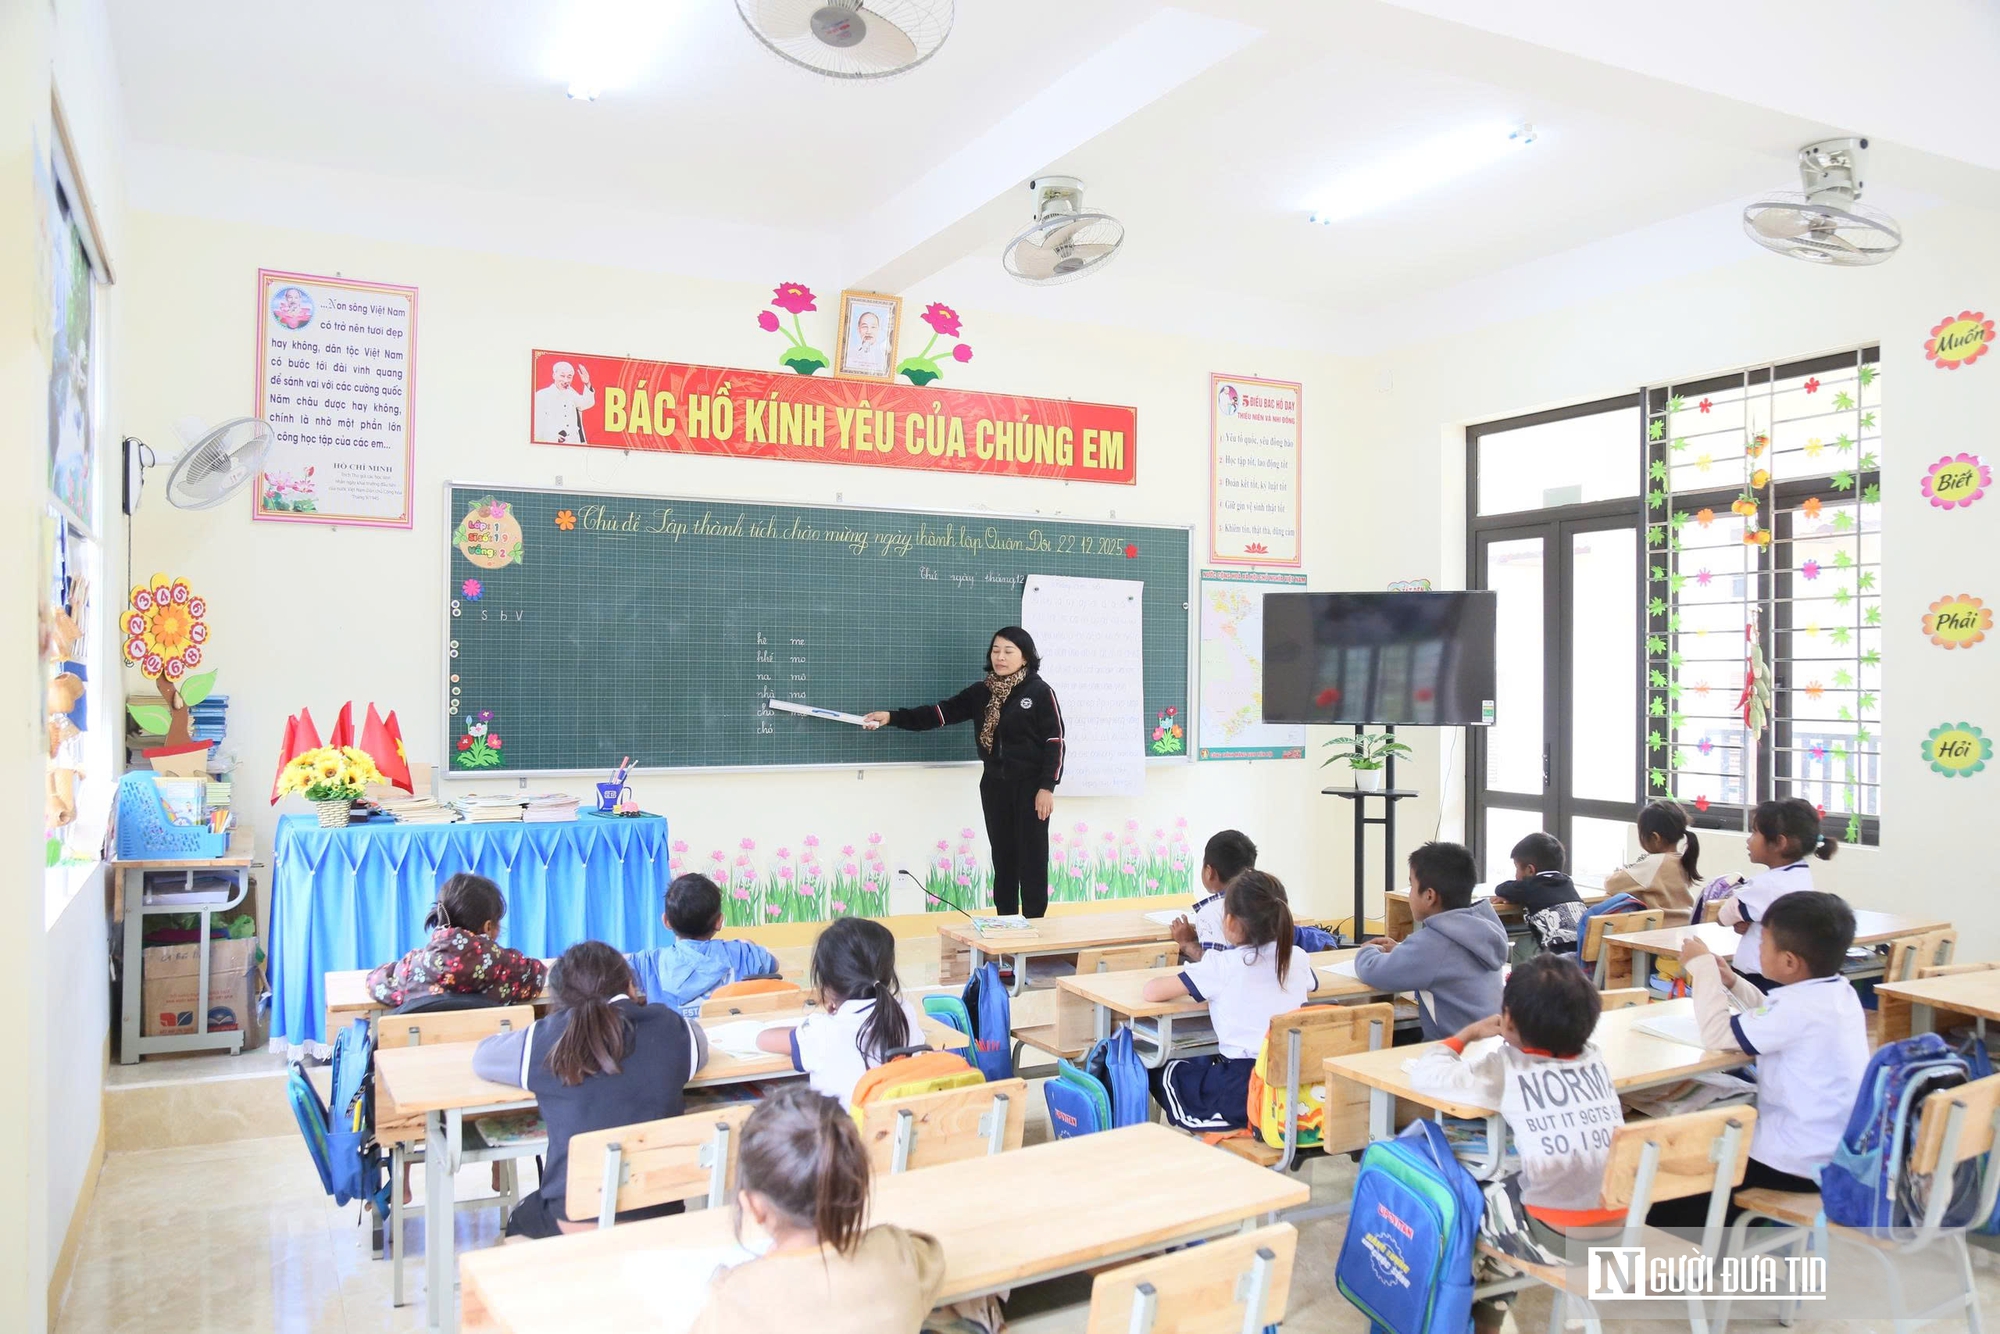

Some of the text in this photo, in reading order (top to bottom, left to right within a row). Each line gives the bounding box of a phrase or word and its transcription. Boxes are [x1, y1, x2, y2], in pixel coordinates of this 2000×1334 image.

[349, 303, 368, 315] sông
[370, 305, 385, 318] Việt
[388, 308, 406, 317] Nam
[320, 320, 403, 339] có trở nên tươi đẹp
[1935, 324, 1984, 354] Muốn
[272, 338, 404, 360] hay không, dân tộc Việt Nam
[270, 357, 402, 380] có bước tới đài vinh quang
[270, 372, 402, 397] để sánh vai với các cường quốc
[270, 394, 402, 416] Năm châu được hay không,
[1242, 394, 1249, 408] 5
[270, 412, 402, 432] chính là nhờ một phần lớn
[604, 380, 1124, 471] BÁC HỒ KÍNH YÊU CỦA CHÚNG EM
[277, 432, 298, 444] công
[300, 432, 316, 446] học
[318, 435, 332, 446] tập
[335, 436, 350, 446] của
[353, 438, 368, 447] các
[333, 461, 348, 470] HỒ
[1937, 468, 1973, 492] Biết
[578, 504, 618, 530] Chủ
[694, 511, 745, 537] thành
[750, 514, 778, 540] tích
[782, 516, 821, 540] chào
[824, 526, 868, 556] mừng
[874, 530, 913, 557] ngày
[916, 523, 956, 548] thành
[959, 526, 982, 556] lập
[984, 527, 1023, 551] Quân
[500, 549, 506, 558] 2
[919, 566, 938, 580] Thứ
[139, 595, 149, 607] 3
[160, 590, 168, 602] 4
[176, 588, 185, 600] 5
[132, 620, 142, 630] 2
[1936, 610, 1978, 631] Phải
[194, 629, 204, 638] 7
[135, 643, 143, 653] 1
[188, 650, 197, 660] 8
[1938, 738, 1972, 758] Hỏi
[1526, 1116, 1556, 1132] BUT
[1561, 1112, 1575, 1128] IT
